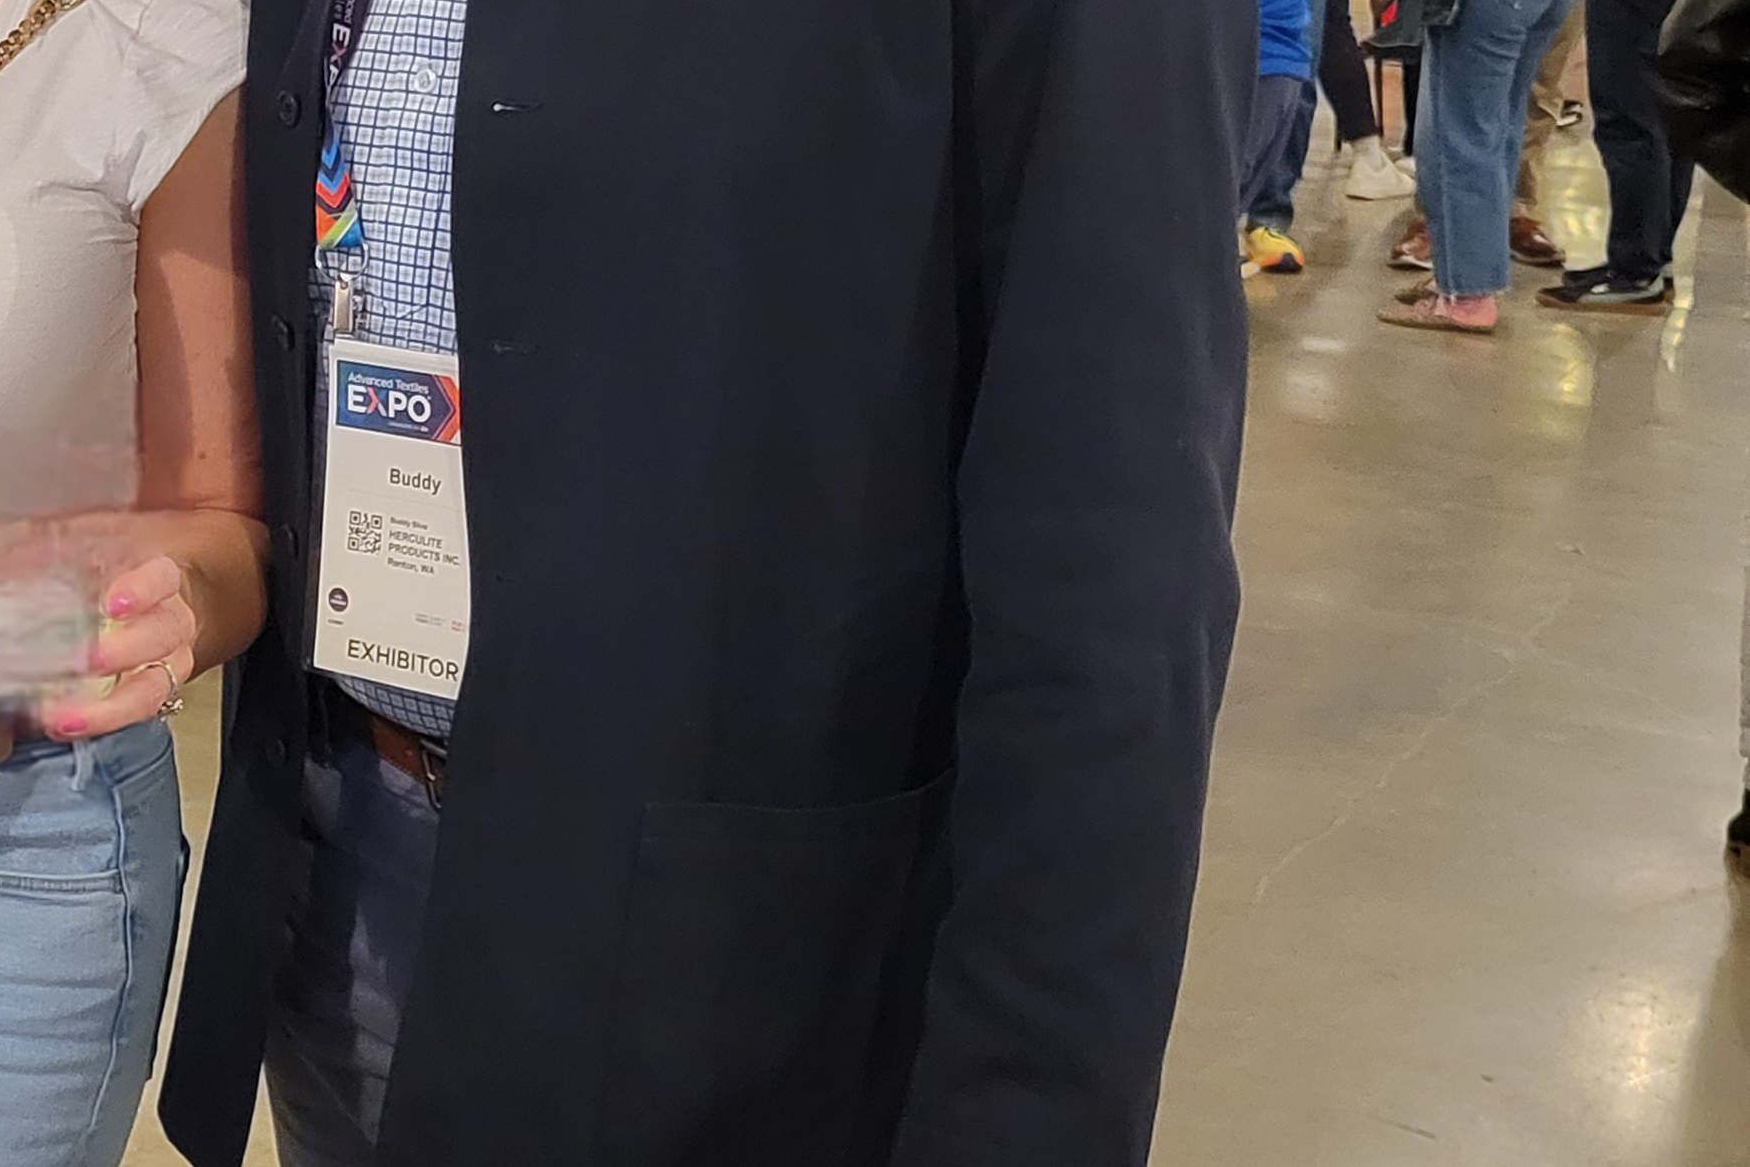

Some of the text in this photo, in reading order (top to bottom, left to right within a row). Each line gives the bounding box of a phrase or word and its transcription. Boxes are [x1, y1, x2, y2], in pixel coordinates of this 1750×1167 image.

[348, 372, 429, 394] Advanced Textiles
[347, 383, 432, 424] EXPO
[390, 467, 441, 496] Buddy
[388, 542, 440, 562] PRODUCTS
[389, 529, 443, 550] HERCULITE
[347, 638, 459, 683] EXHIBITOR
